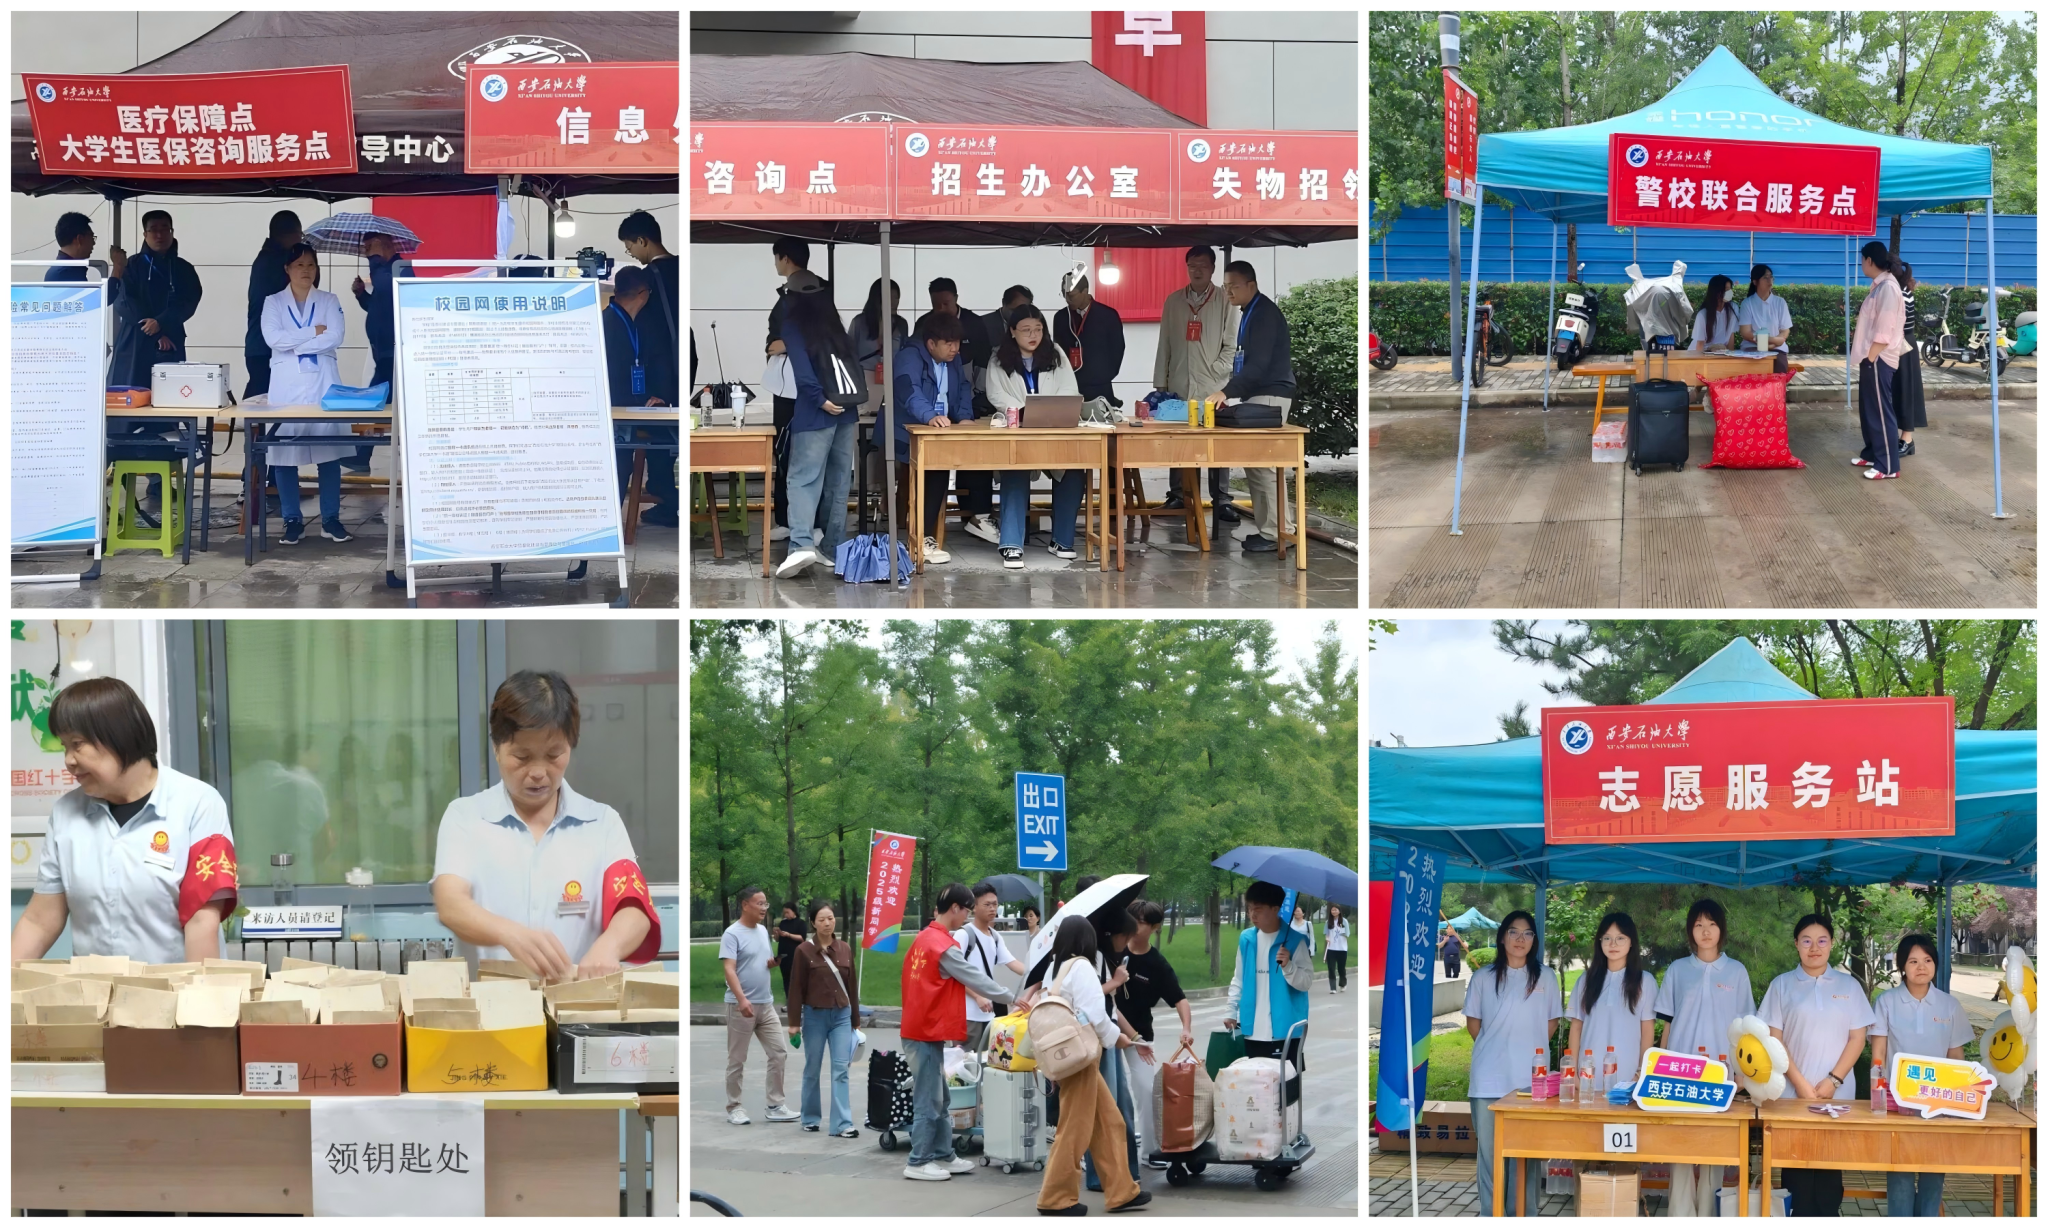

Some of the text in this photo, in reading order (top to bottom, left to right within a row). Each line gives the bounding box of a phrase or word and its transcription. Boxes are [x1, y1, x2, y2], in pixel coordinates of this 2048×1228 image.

[117, 103, 256, 134] 医疗保障点
[1671, 109, 1825, 127] honor
[59, 131, 331, 165] 大学生医保咨询服务点
[355, 135, 454, 164] 导中心
[704, 160, 838, 195] 咨询点
[931, 161, 1139, 199] 招生办公室
[1635, 175, 1857, 217] 警校联合服务点
[435, 296, 567, 311] 校园网使用说明
[11, 769, 77, 786] 国红十字
[1598, 758, 1900, 813] 志愿服务站
[1024, 782, 1058, 809] 出口
[1024, 814, 1059, 835] EXIT
[196, 850, 239, 889] 安全
[885, 863, 903, 906] 热烈欢迎
[868, 861, 889, 936] 2025级新同学
[252, 911, 335, 924] 来访人员请登记
[1409, 853, 1437, 981] 热烈欢迎
[611, 1041, 650, 1067] 6楼
[1659, 1061, 1701, 1074] 一起打卡
[302, 1061, 357, 1089] 4楼
[441, 1061, 500, 1087] 5楼
[1907, 1065, 1936, 1082] 遇见
[1648, 1080, 1724, 1102] 西安石油大学
[1919, 1085, 1976, 1103] 更好的自己
[1612, 1132, 1633, 1148] 01
[325, 1142, 470, 1175] 领钥匙处
